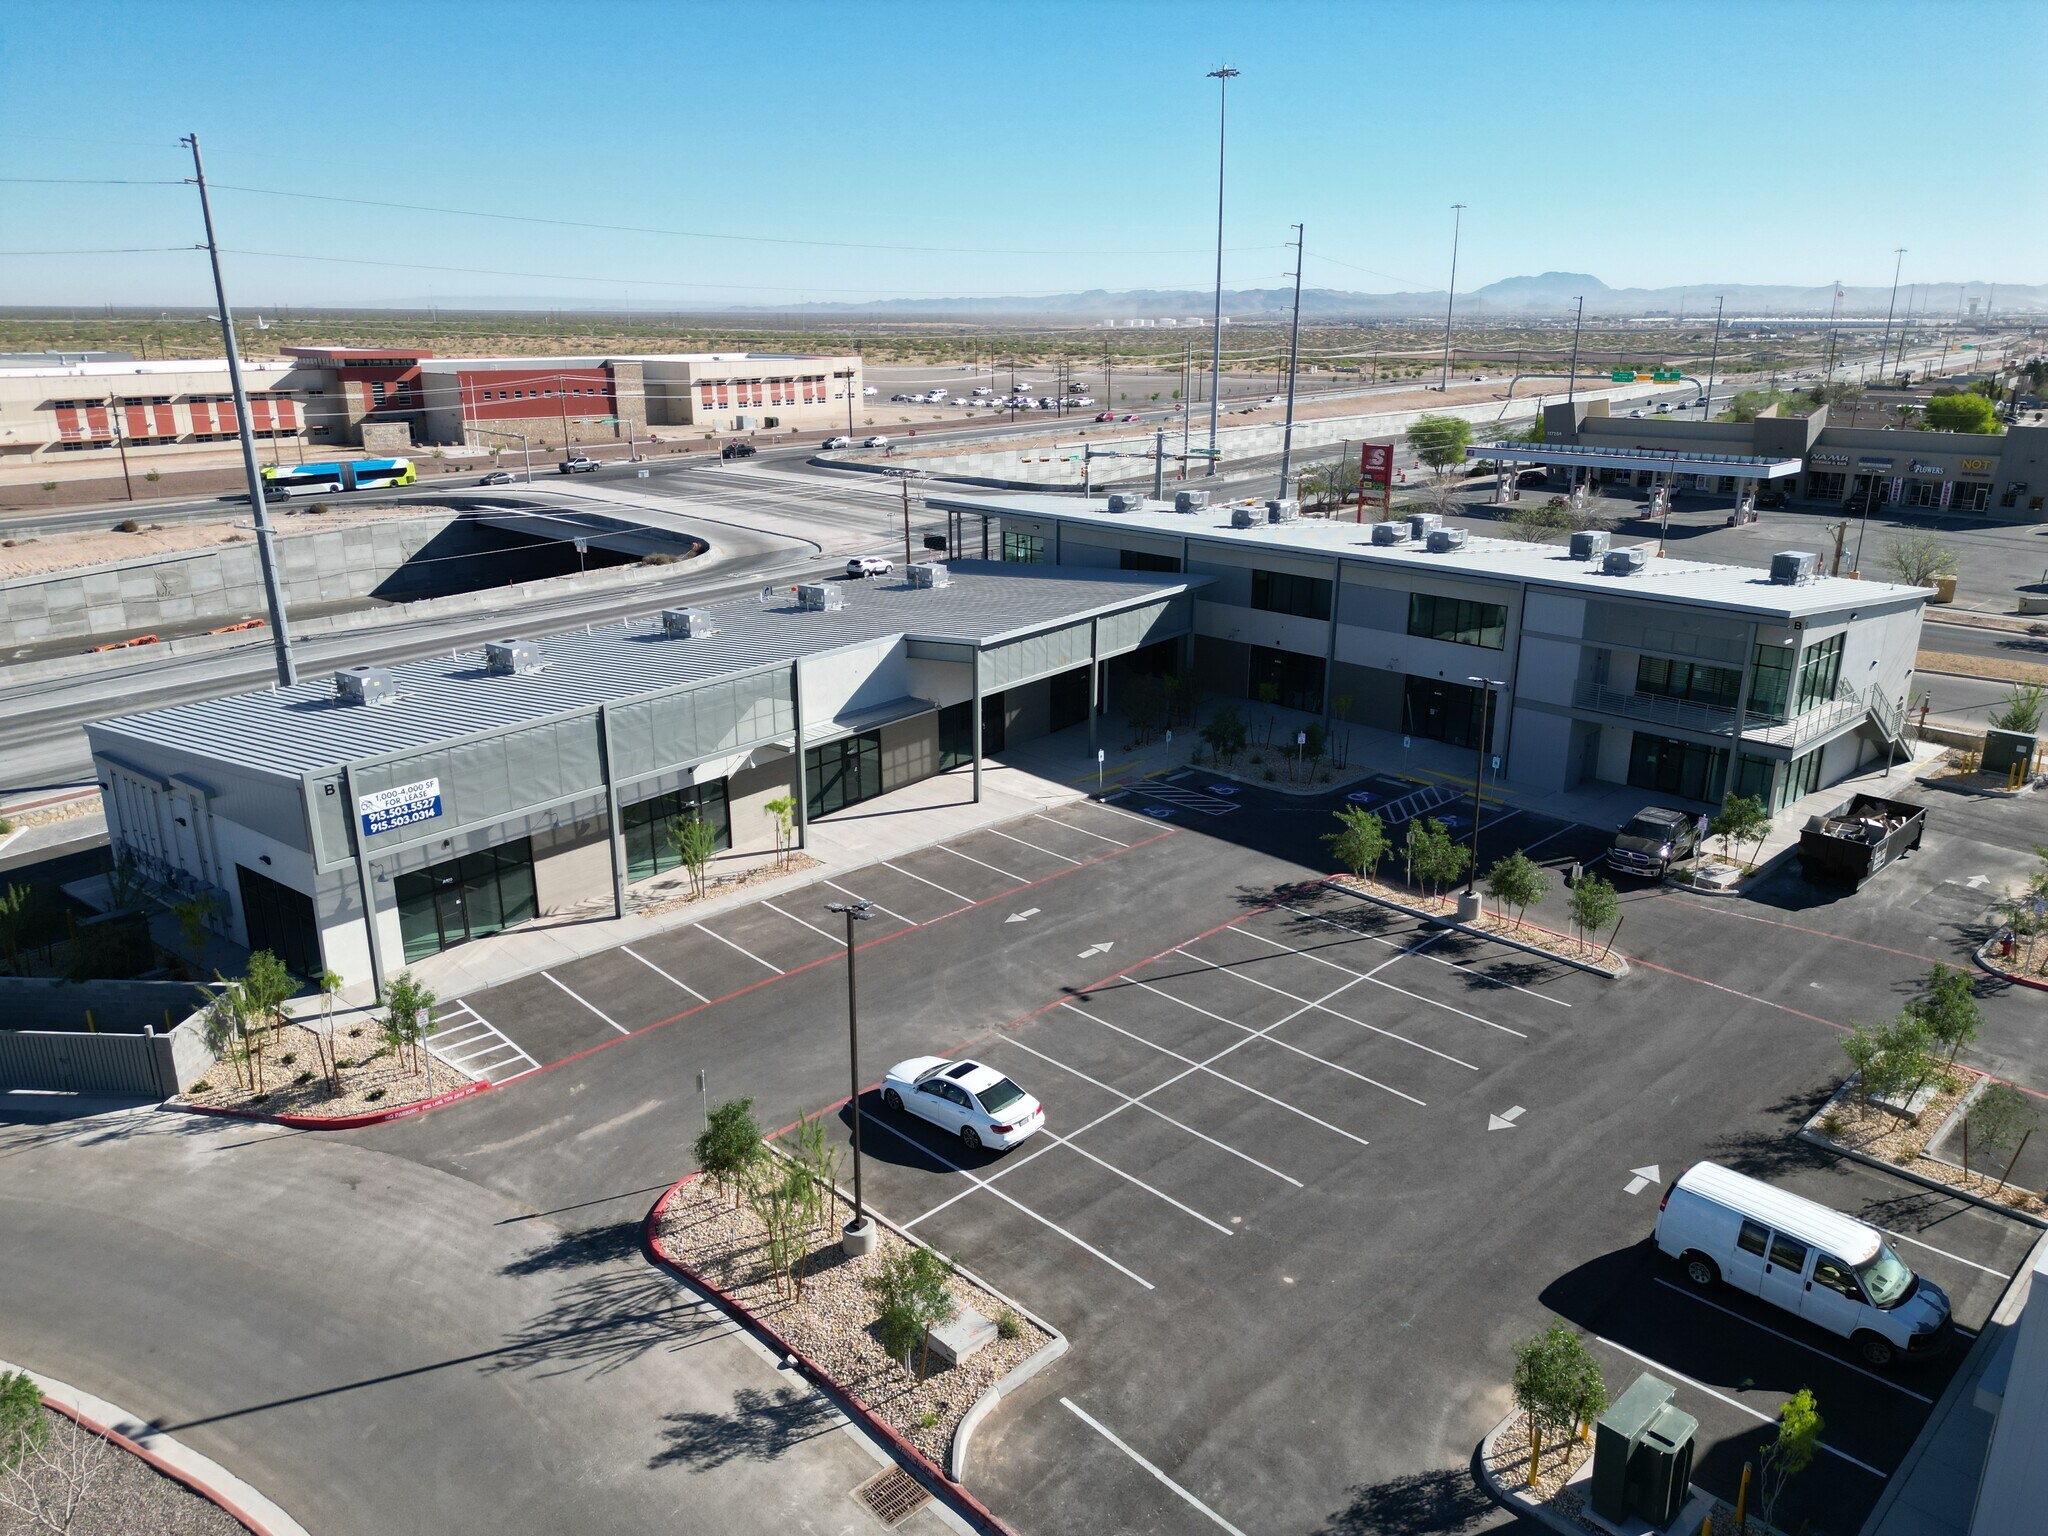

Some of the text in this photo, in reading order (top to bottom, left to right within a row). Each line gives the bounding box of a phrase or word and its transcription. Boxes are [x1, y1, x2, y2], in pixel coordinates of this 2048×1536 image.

[1914, 464, 1944, 474] FLOWERS
[1962, 460, 1991, 470] NOT
[1794, 621, 1802, 630] B
[324, 784, 335, 796] B
[375, 780, 435, 801] 1,000-4,000 SF
[385, 790, 428, 807] FOR LEASE
[369, 797, 435, 822] 915.503.5527
[370, 808, 435, 833] 915.503.0314
